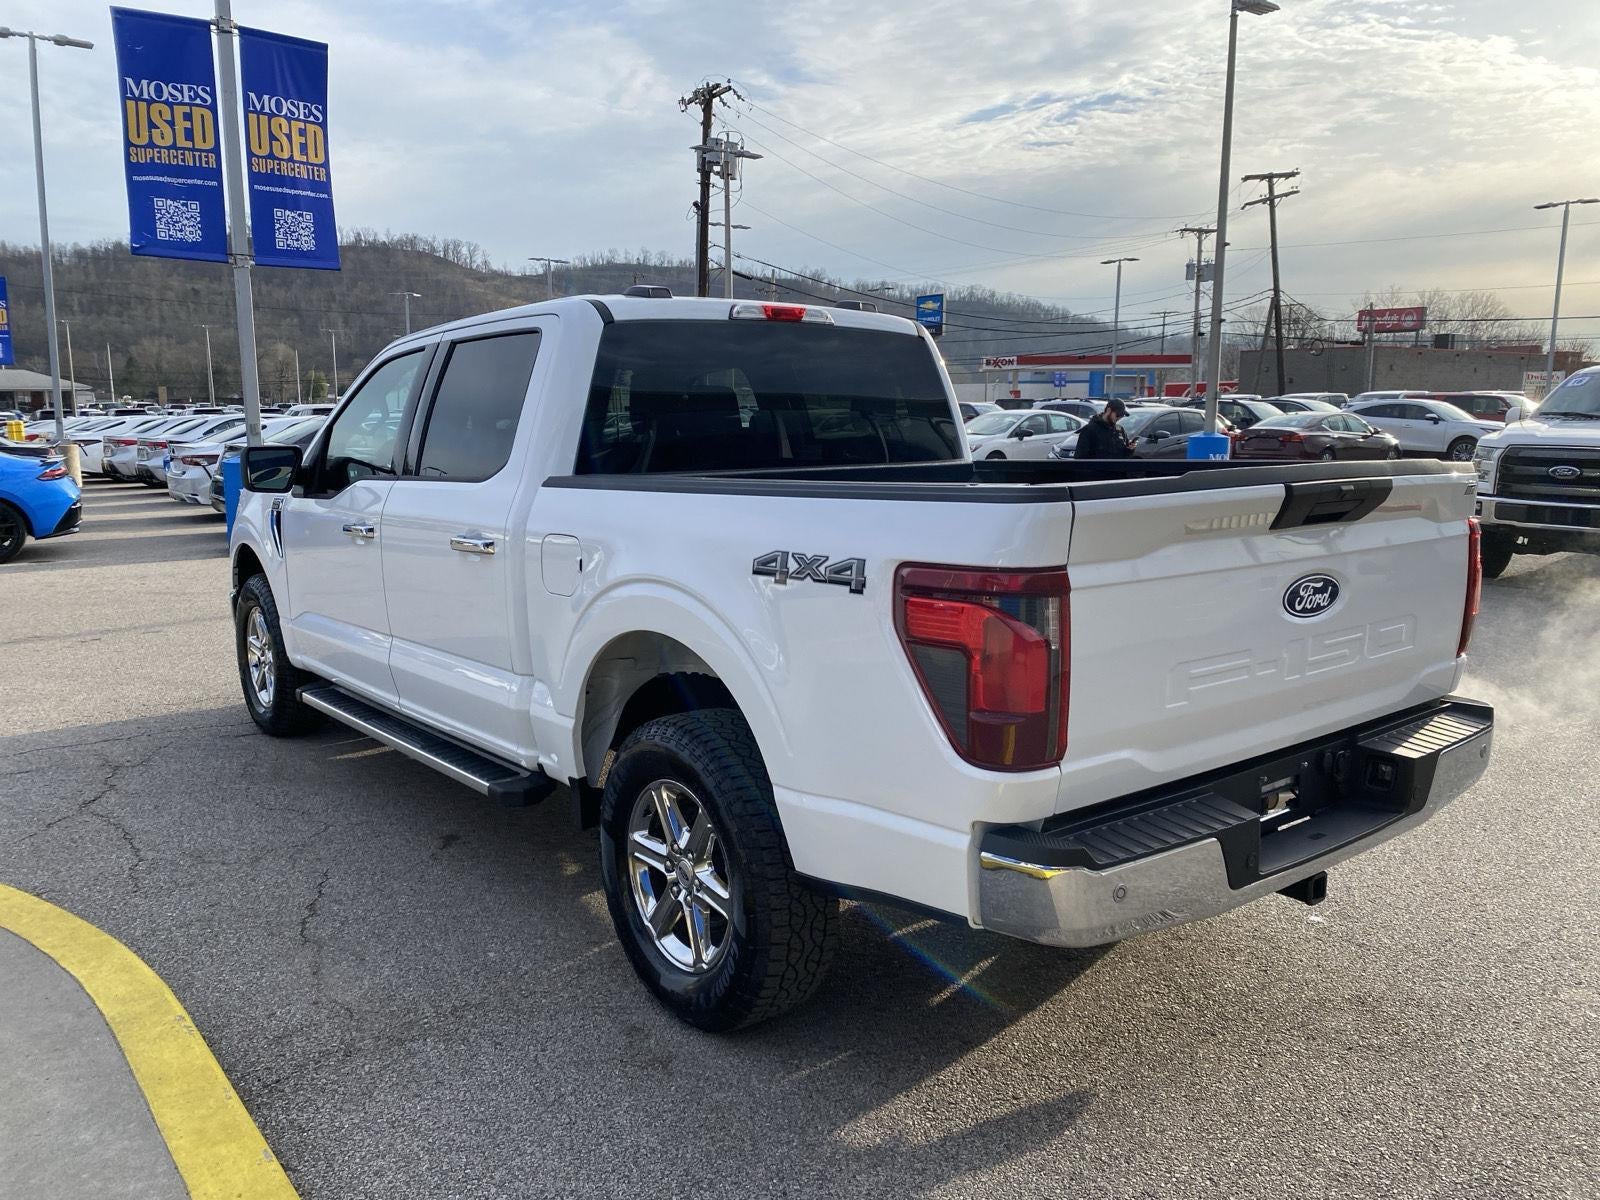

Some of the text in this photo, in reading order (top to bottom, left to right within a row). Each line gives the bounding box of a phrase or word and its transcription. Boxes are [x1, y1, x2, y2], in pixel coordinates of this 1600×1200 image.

[124, 77, 211, 105] MOSES
[248, 92, 322, 122] MOSES
[126, 100, 214, 149] USED
[248, 113, 325, 164] USED
[129, 147, 216, 168] SUPERCENTER
[251, 157, 326, 181] SUPERCENTER
[132, 175, 217, 187] mosesusedsupercenter.com
[253, 184, 328, 198] mosesusedsupercenter.com
[985, 357, 1015, 369] EXXON
[1295, 581, 1332, 611] Ford
[1166, 613, 1417, 708] F-150
